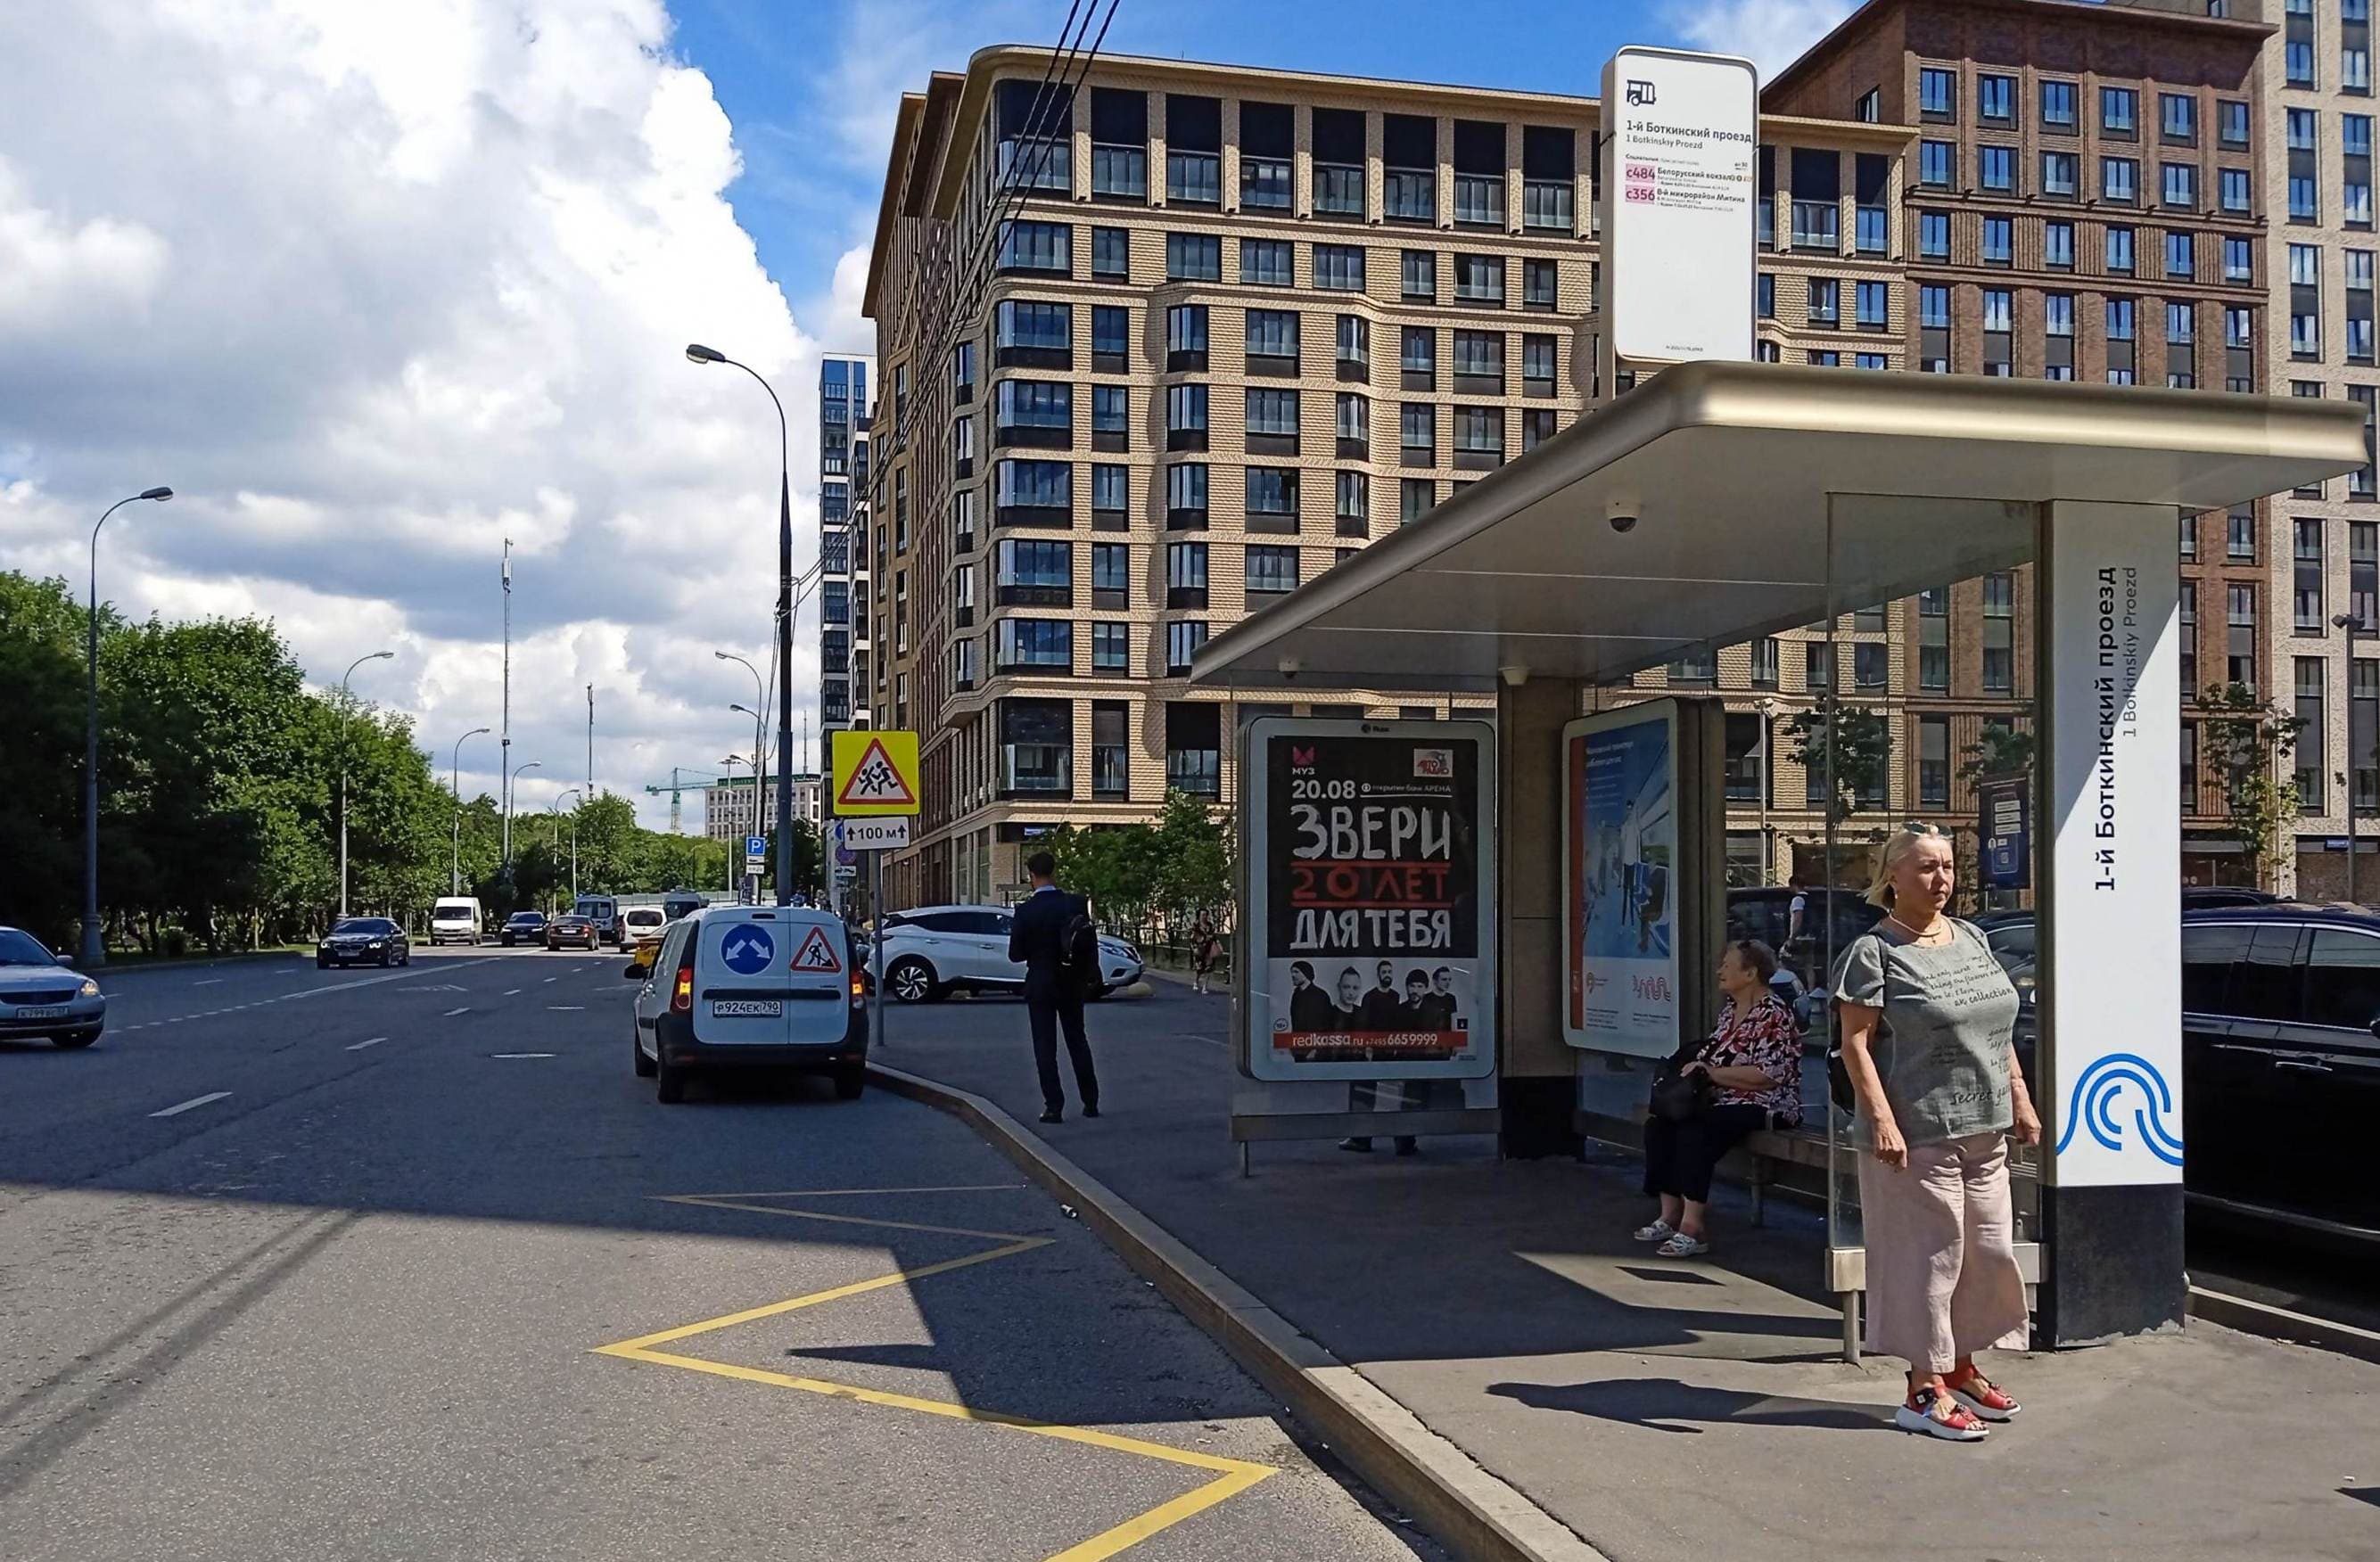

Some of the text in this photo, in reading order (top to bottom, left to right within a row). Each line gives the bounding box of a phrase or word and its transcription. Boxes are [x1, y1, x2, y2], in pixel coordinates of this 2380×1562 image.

[1626, 119, 1752, 143] 1-й Боткинский проезд
[1633, 136, 1675, 148] Botkinskiy
[1676, 140, 1703, 149] Proezd
[1658, 167, 1705, 178] Белорусский
[1669, 190, 1716, 201] микрорайон
[1717, 193, 1746, 203] Митина
[2122, 566, 2139, 738] 1 Botkinskiy Proezd
[2094, 566, 2120, 892] 1-й Боткинский проезд
[1292, 768, 1316, 776] МУЗ
[1291, 779, 1356, 800] 20.08
[1423, 785, 1452, 793] АРЕНА
[858, 827, 883, 840] 100
[1289, 803, 1451, 860] ЗВЕРИ
[1292, 866, 1448, 900] 20 ЛЕТ
[1289, 908, 1451, 950] ДЛЯ ТЕБЯ
[762, 1000, 779, 1012] 790
[1387, 1032, 1438, 1046] 6659999
